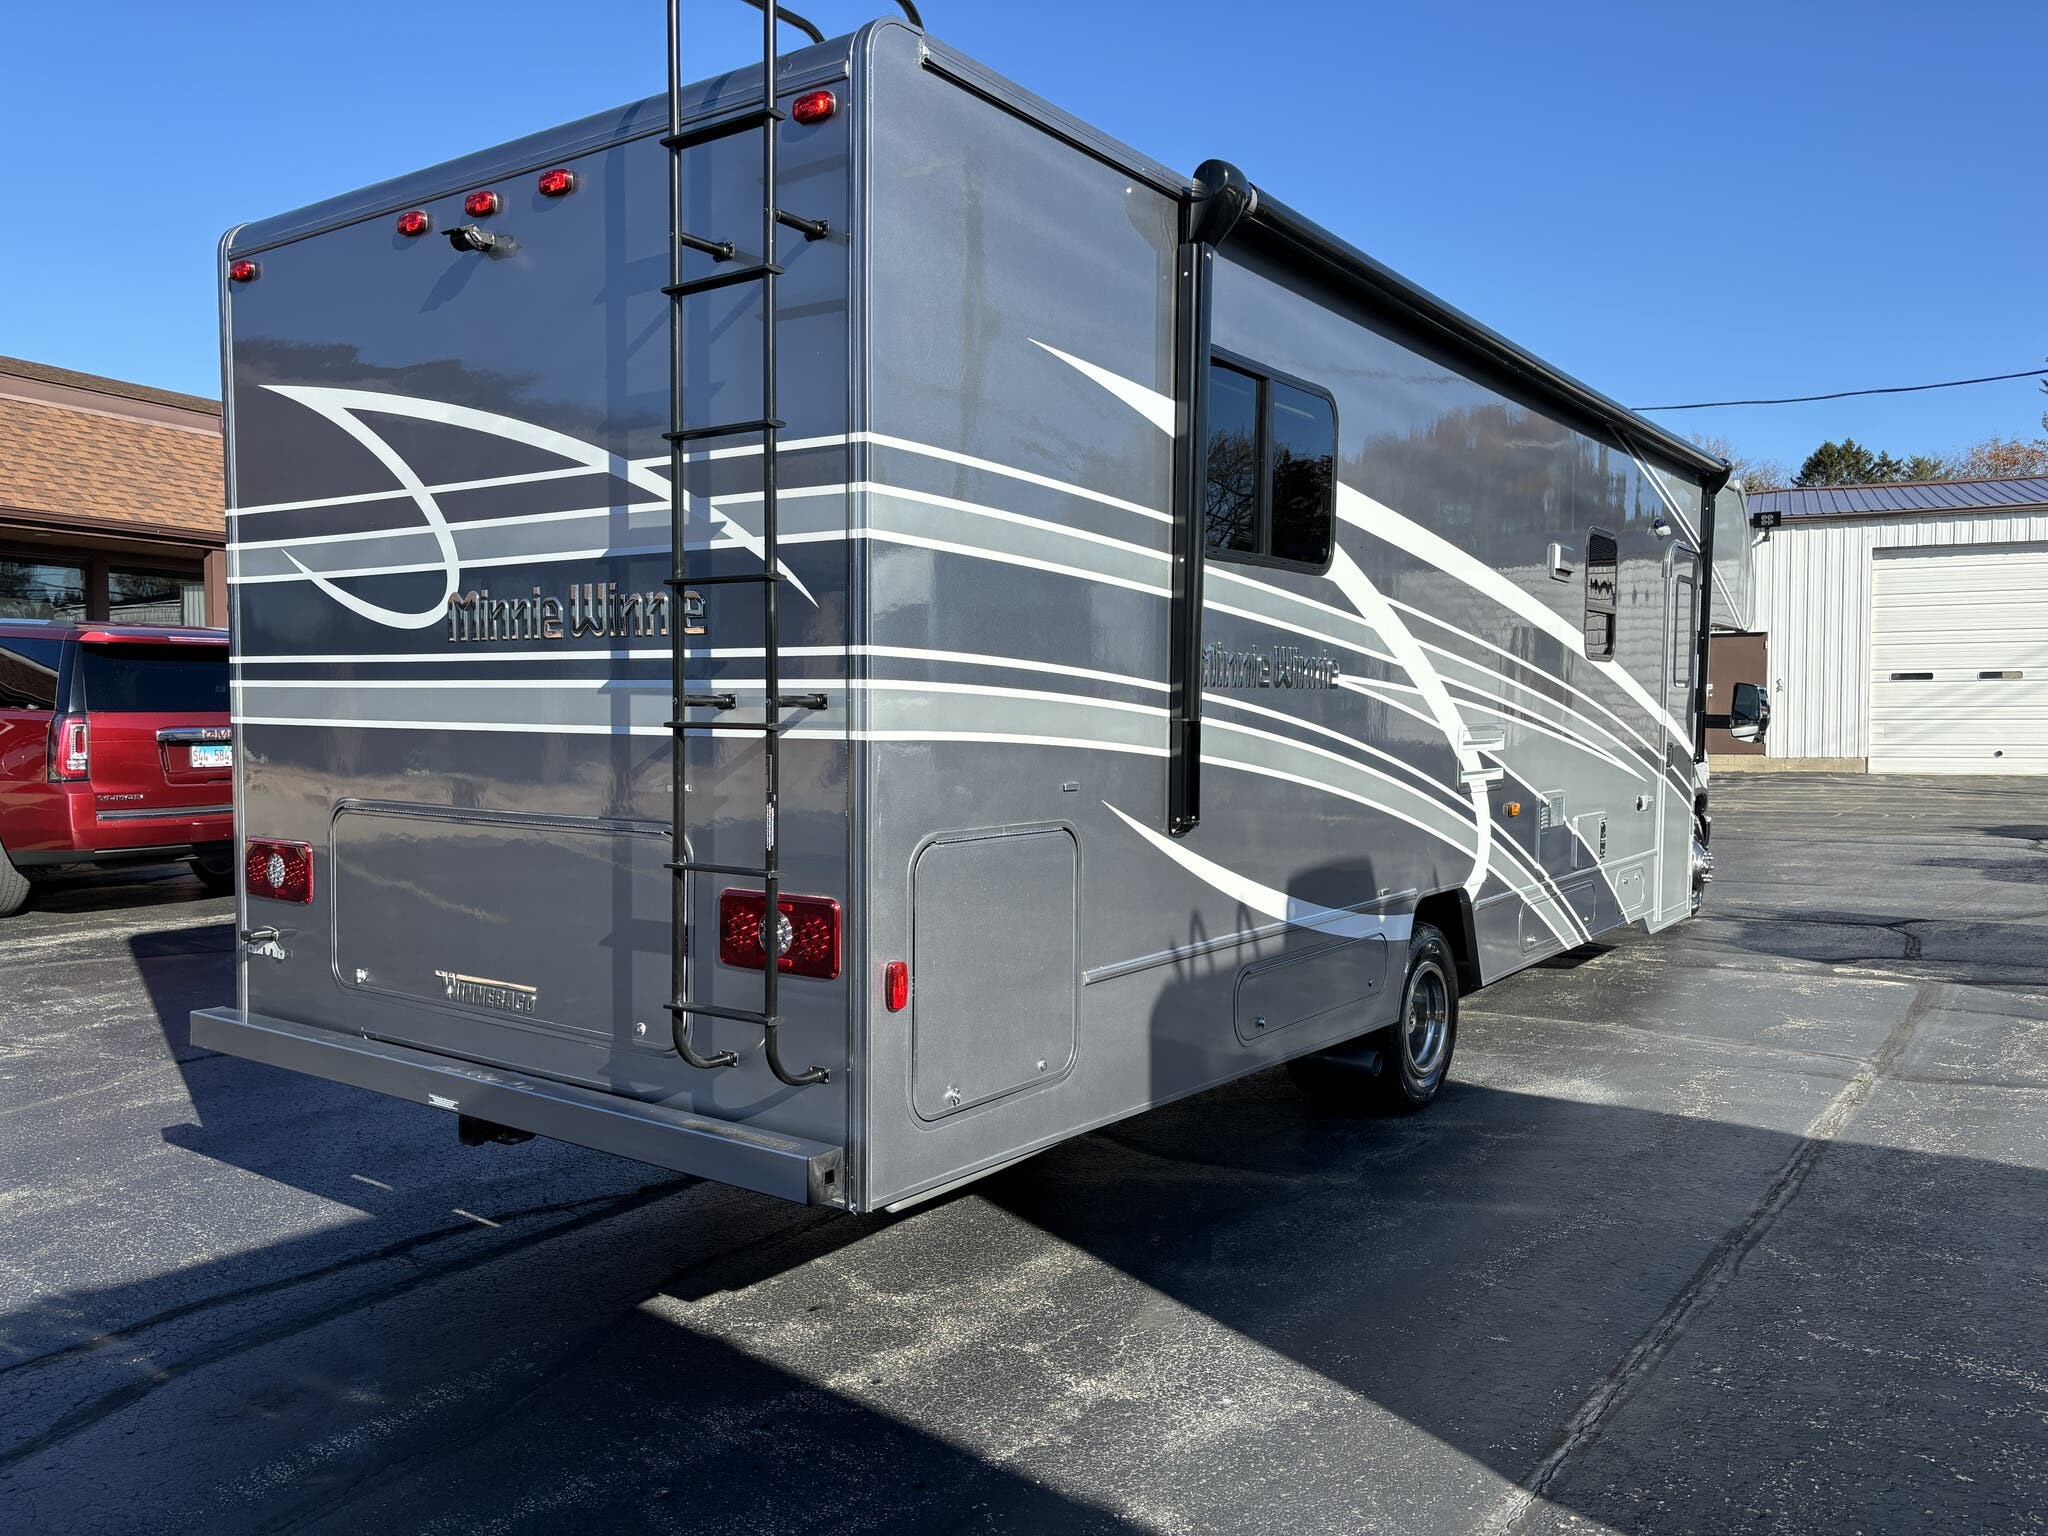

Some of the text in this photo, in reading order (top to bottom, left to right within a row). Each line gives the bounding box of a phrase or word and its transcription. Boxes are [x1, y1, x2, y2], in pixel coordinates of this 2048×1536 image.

[448, 582, 707, 642] Minnie Winne
[1273, 645, 1340, 690] Winnie
[440, 970, 537, 1015] WINNEBAGO
